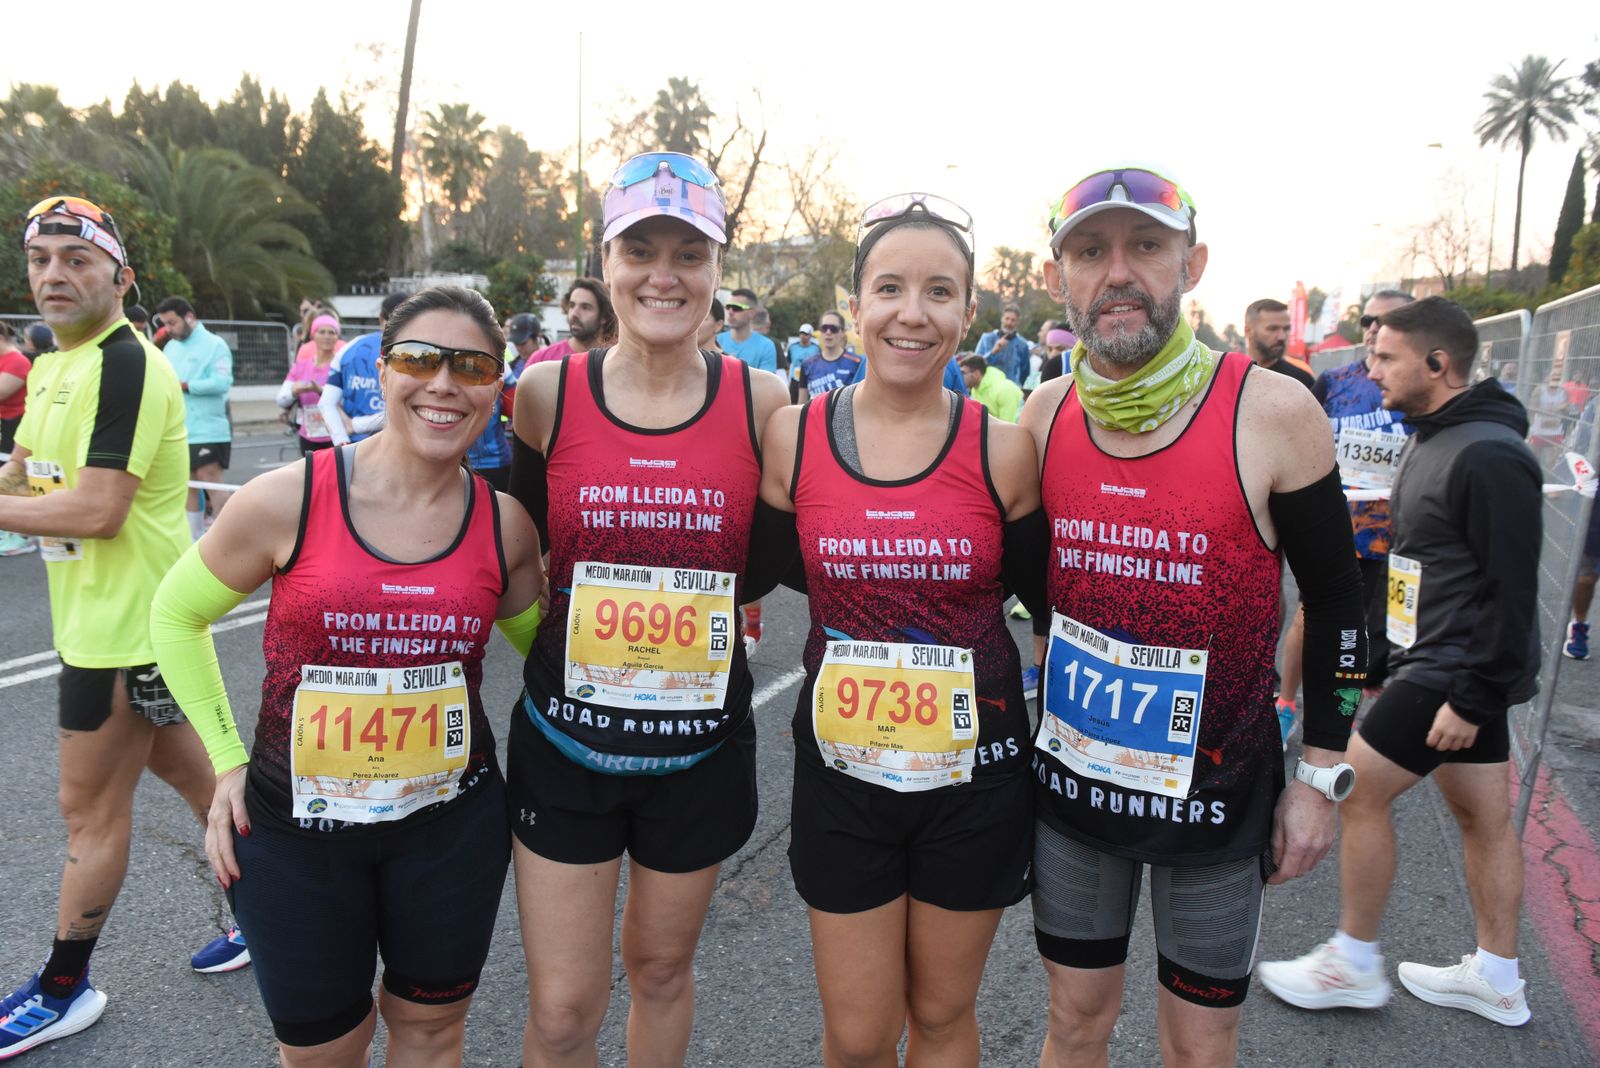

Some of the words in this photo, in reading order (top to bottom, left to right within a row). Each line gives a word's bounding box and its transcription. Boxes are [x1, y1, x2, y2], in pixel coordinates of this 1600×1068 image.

[1343, 443, 1393, 465] 13354
[579, 486, 628, 504] FROM
[633, 486, 698, 506] LLEIDA
[702, 489, 725, 508] TO
[581, 510, 615, 528] THE
[620, 511, 681, 529] FINISH
[685, 513, 723, 533] LINE
[819, 538, 867, 556] FROM
[872, 538, 943, 556] LLEIDA
[947, 539, 972, 556] TO
[1055, 518, 1094, 541] FROM
[1099, 522, 1170, 552] LLEIDA
[1177, 531, 1208, 555] TO
[585, 565, 611, 580] MEDIO
[613, 567, 652, 584] MARATÓN
[823, 562, 857, 579] THE
[860, 563, 927, 579] FINISH
[932, 564, 971, 580] LINE
[1056, 546, 1082, 569] THE
[1085, 550, 1150, 580] FINISH
[1155, 560, 1203, 585] LINE
[673, 570, 717, 592] SEVILLA
[323, 612, 381, 631] FROM
[386, 614, 456, 633] LLEIDA
[463, 616, 481, 634] TO
[594, 598, 697, 648] 9696
[328, 635, 365, 653] THE
[371, 637, 437, 655] FINISH
[440, 640, 475, 655] LINE
[1061, 619, 1079, 639] MEDIO
[1080, 628, 1109, 654] MARATÓN
[628, 645, 661, 655] RACHEL
[832, 644, 851, 657] MEDIO
[853, 644, 889, 660] MARATÓN
[912, 646, 955, 667] SEVILLA
[1130, 646, 1181, 669] SEVILLA
[622, 661, 642, 669] Aguila
[307, 670, 333, 685] MEDIO
[336, 670, 377, 687] MARATÓN
[403, 666, 446, 689] SEVILLA
[633, 693, 657, 702] HOKA
[837, 676, 939, 726] 9738
[1064, 659, 1158, 724] 1717
[547, 697, 610, 729] ROAD
[310, 703, 438, 752] 11471
[878, 725, 896, 733] MAR
[890, 742, 904, 750] Mas
[367, 755, 385, 763] Ana
[1087, 762, 1111, 775] HOKA
[881, 771, 904, 784] HOKA
[368, 804, 394, 814] HOKA
[1091, 786, 1226, 825] RUNNERS
